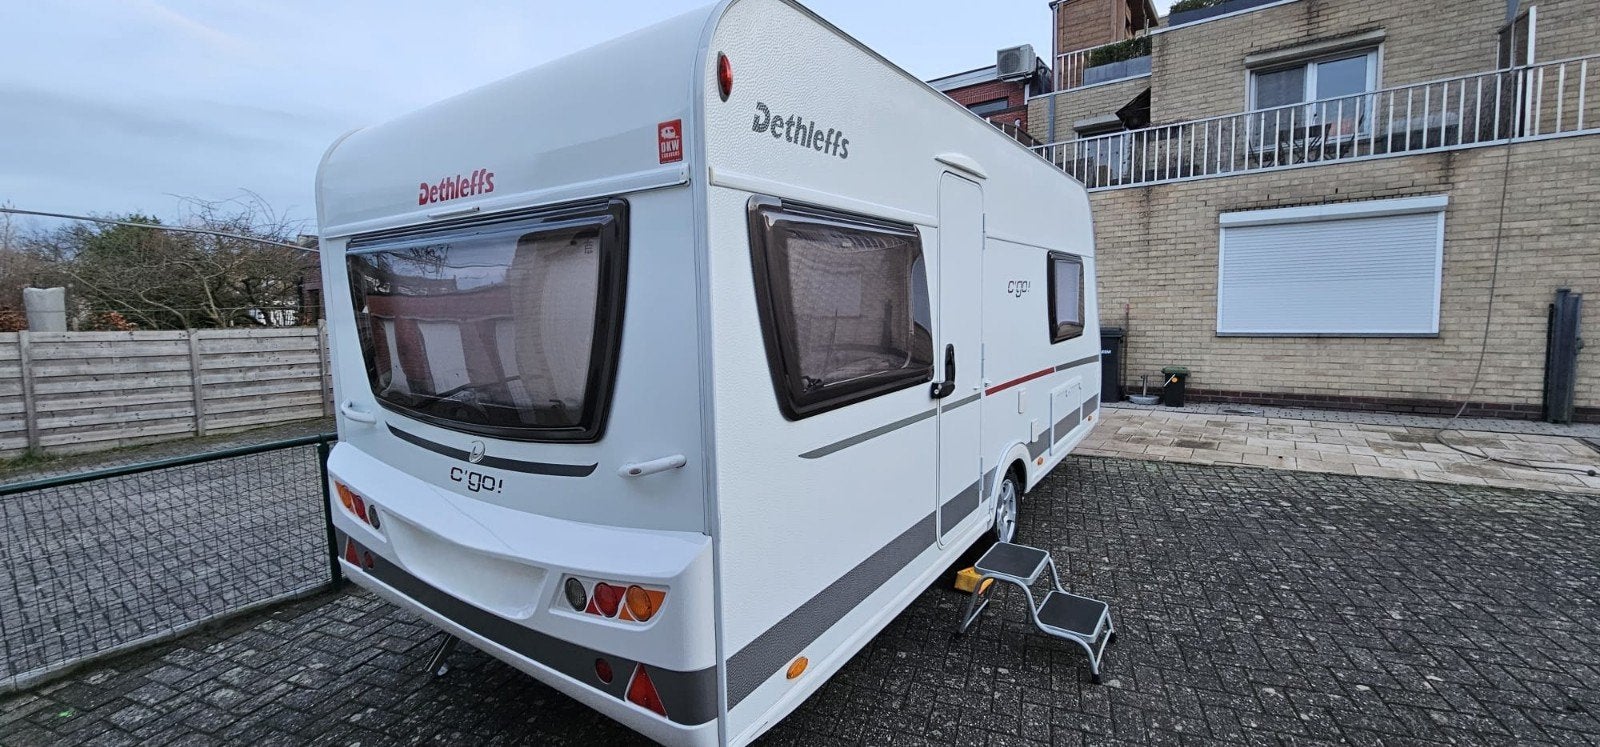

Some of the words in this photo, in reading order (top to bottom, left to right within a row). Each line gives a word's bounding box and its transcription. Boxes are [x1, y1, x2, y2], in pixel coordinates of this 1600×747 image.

[661, 139, 680, 153] DKW
[752, 101, 849, 159] Dethleffs
[418, 168, 494, 206] Dethleffs
